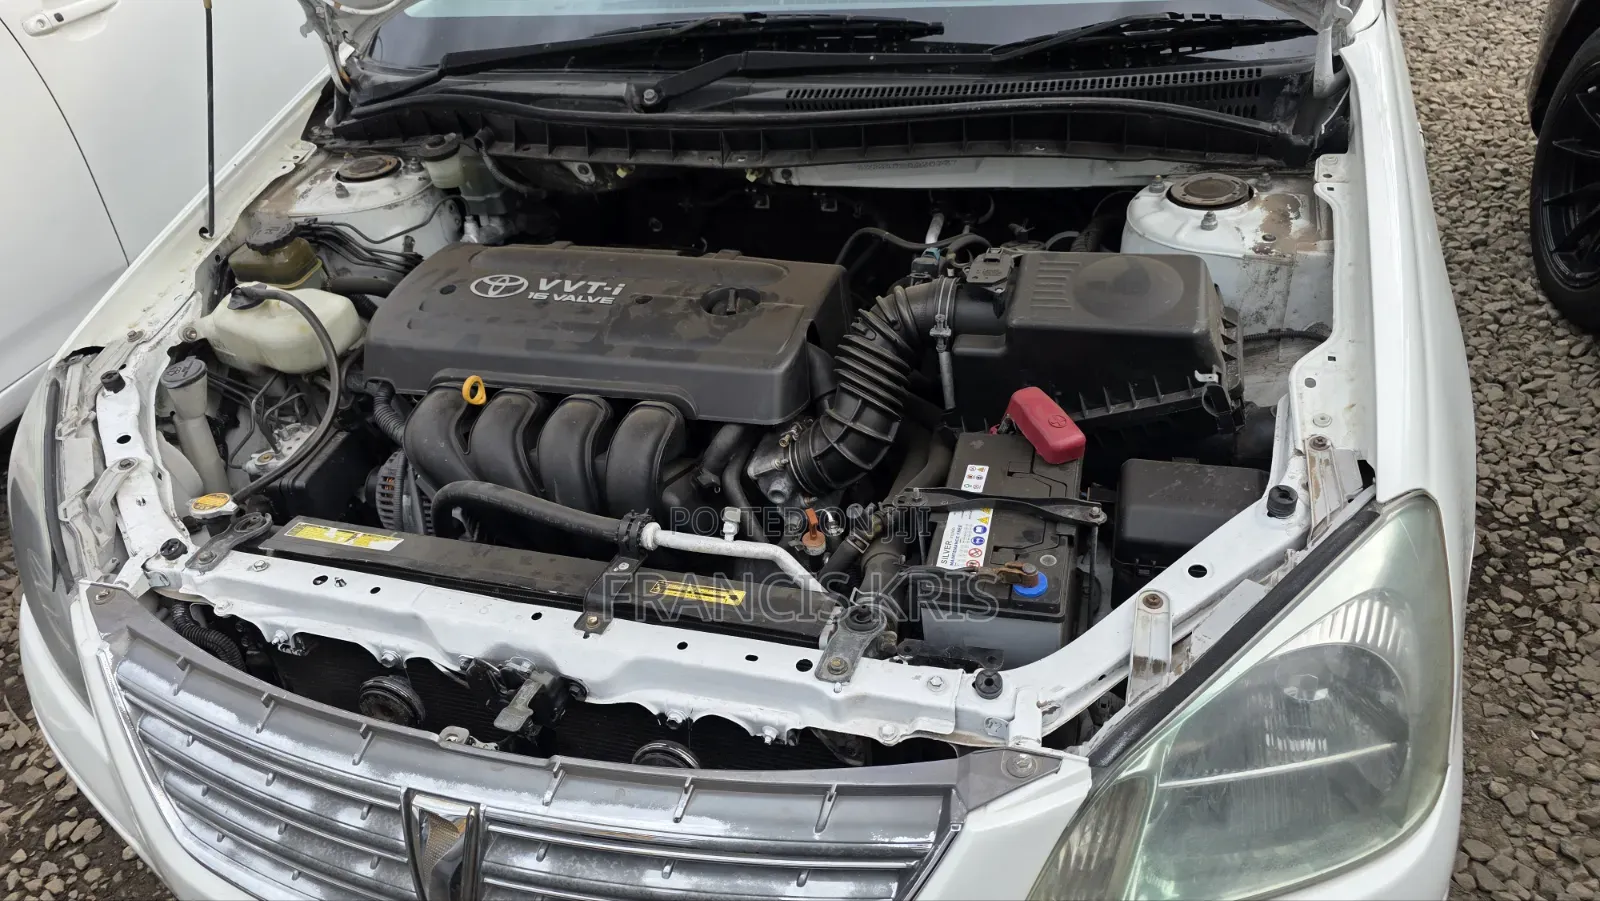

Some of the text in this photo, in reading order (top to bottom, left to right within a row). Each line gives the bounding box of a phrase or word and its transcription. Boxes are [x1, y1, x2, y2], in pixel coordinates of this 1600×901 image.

[539, 278, 626, 296] VVT-i
[527, 291, 616, 305] 16 VALVE
[941, 540, 951, 564] SILVER
